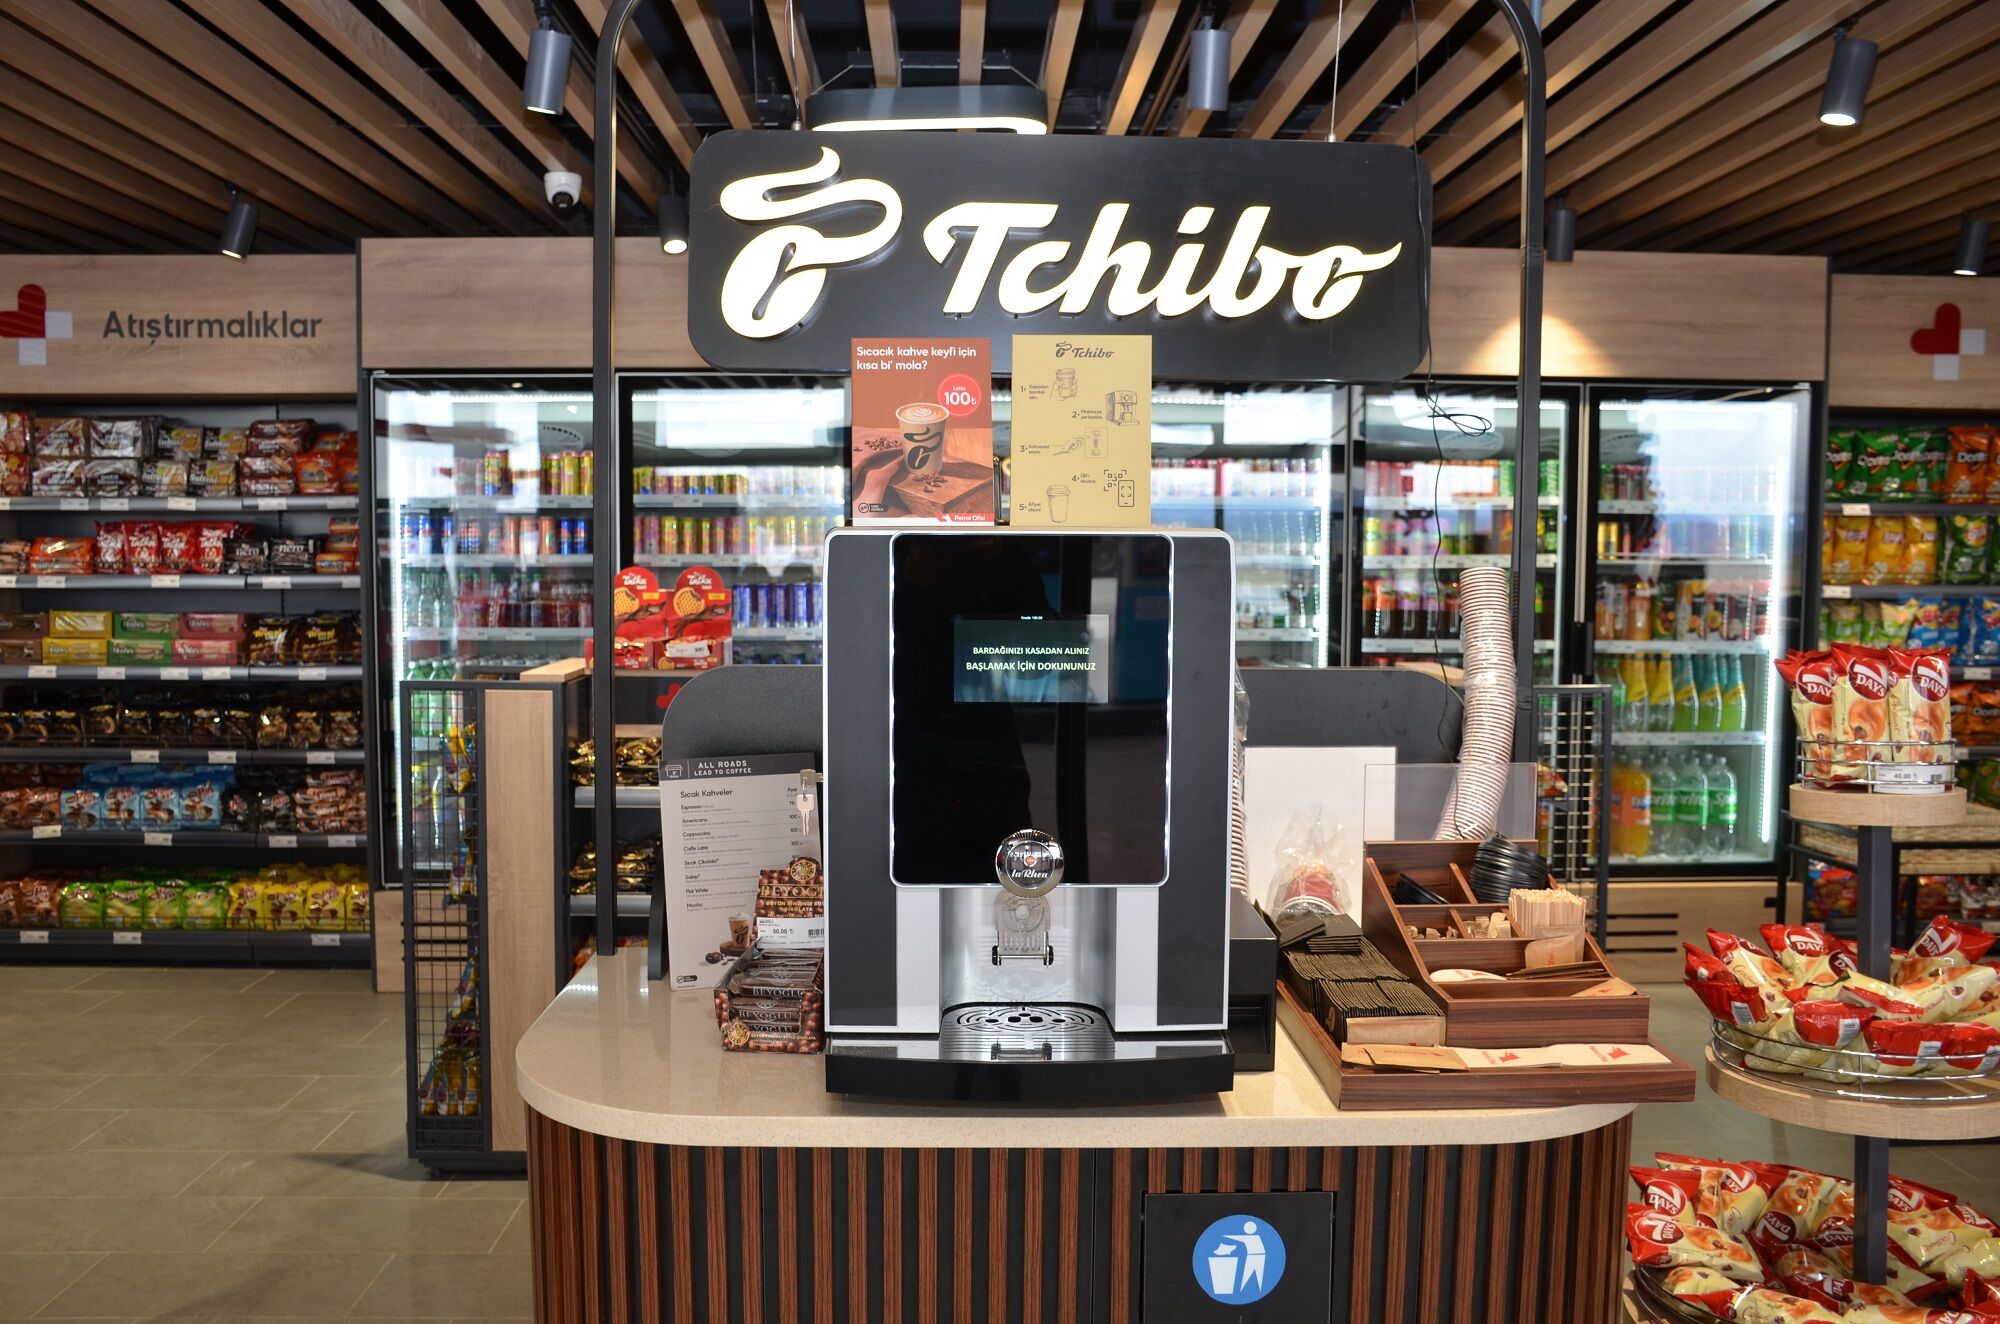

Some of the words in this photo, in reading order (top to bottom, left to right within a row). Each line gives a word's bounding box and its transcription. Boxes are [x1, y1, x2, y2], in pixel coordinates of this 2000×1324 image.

[922, 202, 1402, 319] Tchibo
[102, 310, 322, 345] Atıştırmalıklar
[856, 346, 894, 357] Sıcacık
[897, 346, 928, 357] kahve
[931, 346, 956, 359] keyfi
[958, 347, 977, 358] için
[1071, 347, 1114, 358] Tchibo
[856, 360, 878, 370] kısa
[880, 360, 892, 370] bi'
[895, 360, 928, 370] mola?
[972, 645, 1024, 655] BARDAĞINIZI
[1025, 647, 1062, 655] KASADAN
[1064, 647, 1090, 655] ALINIZ
[966, 662, 1015, 672] BAŞLAMAK
[1017, 660, 1036, 672] İÇİN
[1037, 662, 1096, 671] DOKUNUNUZ
[1807, 683, 1832, 698] DAY
[1856, 673, 1885, 697] DAYS
[1920, 676, 1946, 698] DAYS
[717, 760, 747, 768] ROADS
[725, 767, 751, 775] COFFEE
[680, 790, 700, 798] Sıcak
[702, 788, 732, 797] Kahveler
[1796, 941, 1822, 950] DAY
[1921, 936, 1939, 957] DAYS
[1648, 1194, 1679, 1215] DAYS
[1765, 1212, 1792, 1234] DAYS
[1662, 1221, 1676, 1240] DAYS
